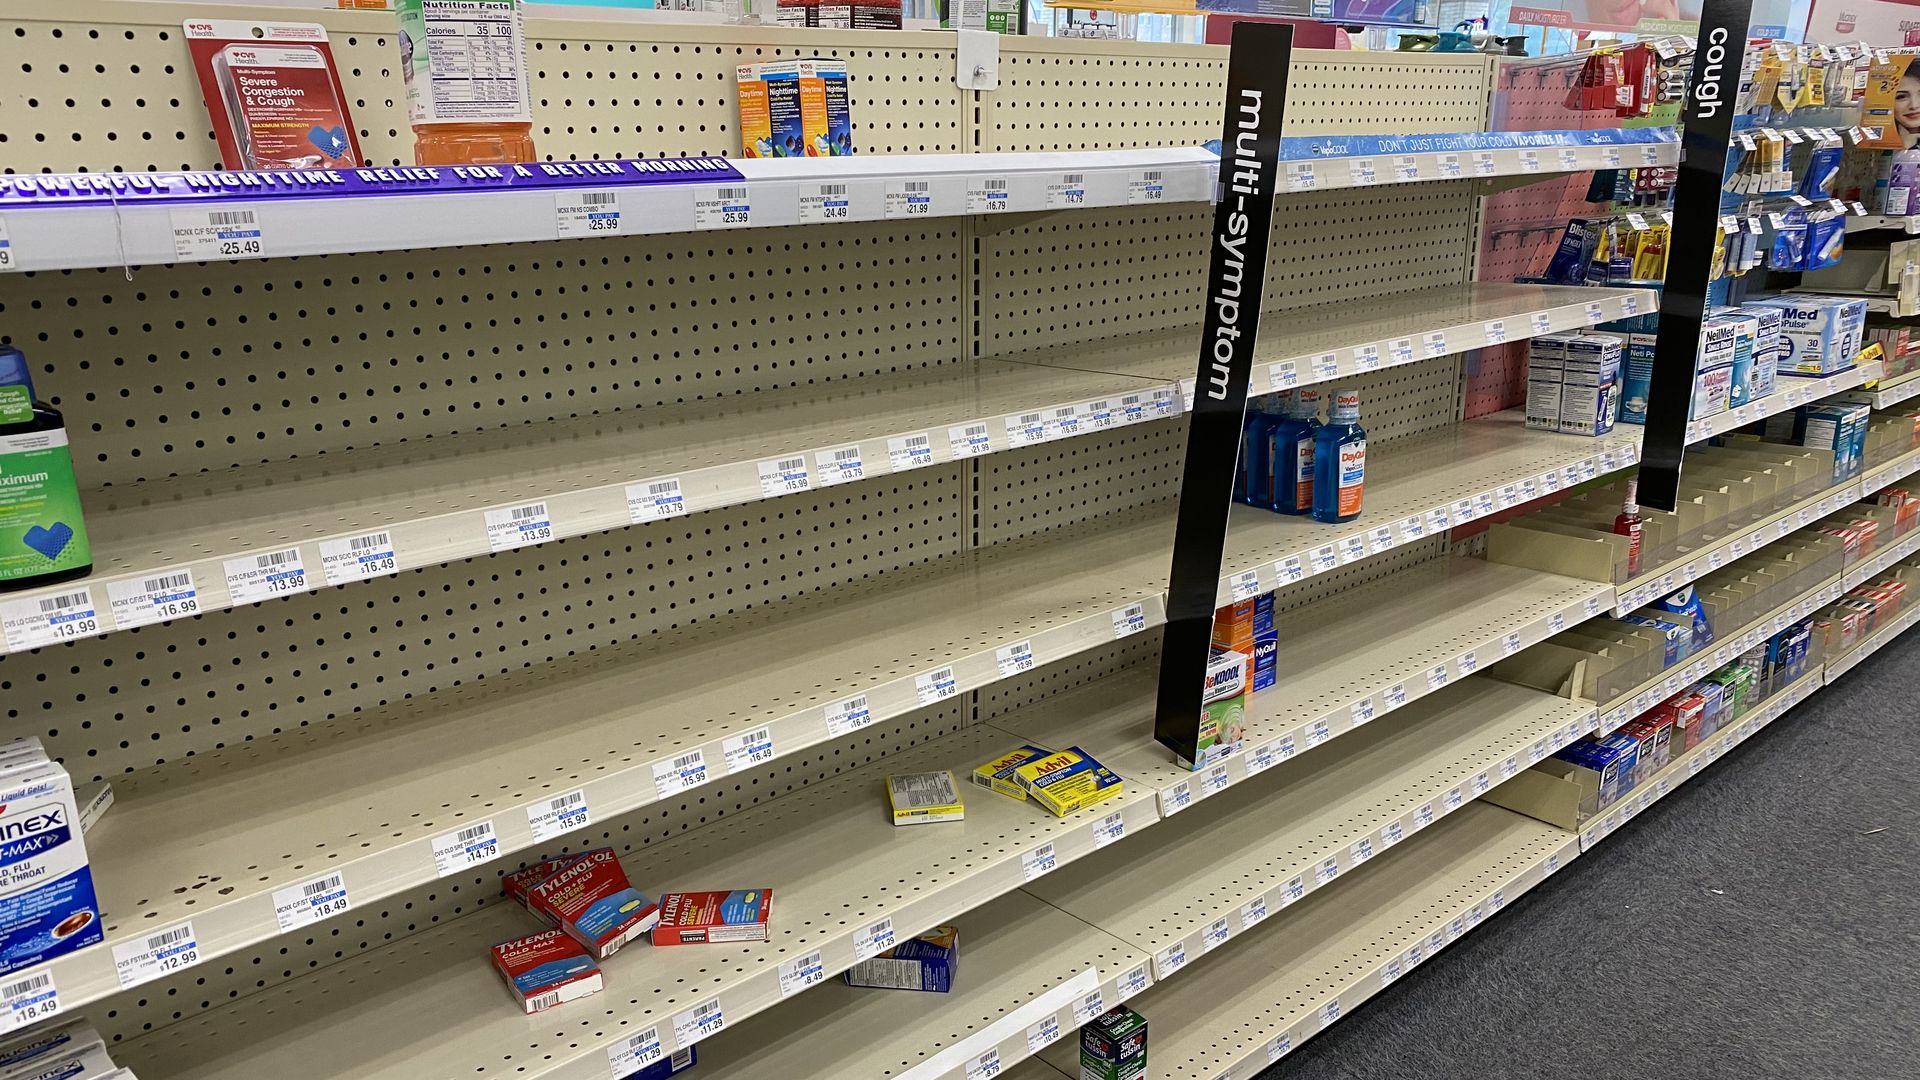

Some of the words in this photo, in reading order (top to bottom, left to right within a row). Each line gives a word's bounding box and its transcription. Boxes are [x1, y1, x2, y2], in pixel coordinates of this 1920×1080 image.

[423, 1, 475, 9] Nutrition
[479, 2, 509, 10] Facts
[1535, 13, 1567, 24] MOISTURIZER
[476, 26, 488, 35] 35
[496, 26, 512, 35] 100
[1695, 27, 1728, 119] cough
[239, 76, 278, 87] Severe
[242, 86, 305, 97] Congestion
[769, 87, 799, 97] Nighttime
[246, 97, 255, 106] &
[257, 97, 295, 107] Cough
[1379, 139, 1408, 153] DON'T
[1410, 139, 1434, 151] JUST
[1435, 137, 1461, 150] FIGHT
[1461, 137, 1488, 148] YOUR
[1489, 136, 1512, 147] COLD
[1512, 134, 1553, 146] VAPORIZE
[0, 174, 170, 195] POWERFUL
[184, 168, 344, 192] NIGHTTIME
[356, 166, 442, 184] RELIEF
[452, 163, 503, 182] FOR
[513, 162, 533, 179] A
[541, 160, 626, 177] BETTER
[631, 157, 730, 175] MORNING
[823, 207, 847, 218] $24.49
[907, 203, 928, 213] $21.99
[986, 201, 1006, 210] $16.79
[589, 219, 618, 230] $25.99
[722, 212, 748, 223] $25.99
[174, 228, 194, 236] MCNX
[194, 228, 205, 236] C/F
[1569, 223, 1596, 241] Blistex
[220, 241, 260, 255] $25.49
[1208, 88, 1262, 401] multi-symptom
[1706, 326, 1735, 343] NeilMed
[1127, 413, 1142, 421] $21.99
[1061, 425, 1078, 434] $16.99
[1026, 433, 1043, 441] $15.99
[971, 444, 989, 454] $21.99
[911, 455, 931, 465] $16.49
[842, 468, 863, 480] $13.79
[786, 479, 808, 491] $15.99
[658, 502, 683, 515] $13.79
[488, 523, 497, 531] CVS
[521, 527, 550, 542] $13.99
[322, 555, 338, 564] MCNX
[352, 551, 362, 559] RLF
[363, 549, 371, 557] LQ
[360, 558, 394, 574] $16.49
[227, 574, 239, 582] CVS
[268, 576, 305, 592] $13.99
[112, 597, 129, 607] MCNX
[158, 600, 197, 617] $16.99
[4, 620, 15, 628] CVS
[53, 619, 96, 638] $13.99
[1256, 641, 1276, 658] NyQuil
[1016, 659, 1033, 671] $12.99
[938, 688, 955, 698] $18.49
[851, 715, 871, 728] $16.49
[750, 750, 772, 763] $16.49
[992, 753, 1026, 772] Advil
[1036, 755, 1072, 776] Advil
[682, 772, 705, 787] $15.99
[1040, 779, 1052, 787] COLD
[27, 784, 48, 796] Gels!
[529, 816, 543, 825] MCNX
[543, 813, 551, 821] DM
[552, 810, 561, 818] RLF
[560, 813, 587, 830] $15.99
[434, 849, 444, 858] CVS
[454, 843, 464, 852] SRE
[464, 839, 476, 849] THRT
[467, 845, 496, 863] $14.79
[14, 862, 31, 875] FLU
[1041, 860, 1055, 871] $8.29
[12, 867, 46, 886] THROAT
[534, 857, 595, 898] TYLENOL
[548, 889, 571, 904] COLD
[576, 872, 593, 885] FLU
[552, 883, 586, 907] SEVERE
[276, 903, 292, 914] MCNX
[292, 897, 309, 909] C/F/ST
[314, 898, 347, 918] $18.49
[658, 894, 681, 927] TYLENOL
[679, 912, 689, 926] COLD
[684, 898, 693, 909] FLU
[495, 929, 564, 955] TYLENOL
[876, 937, 895, 950] $11.29
[502, 948, 529, 959] COLD
[533, 940, 555, 951] MAX
[117, 959, 129, 969] CVS
[130, 954, 150, 965] FSTMX
[160, 951, 197, 972] $12.99
[805, 972, 823, 984] $8.49
[16, 1000, 57, 1023] $18.49
[701, 1018, 723, 1035] $11.29
[1102, 1013, 1123, 1026] tussin
[1085, 1032, 1101, 1046] Safe
[1120, 1038, 1136, 1053] Safe
[637, 1048, 661, 1065] $11.29
[1085, 1041, 1107, 1058] tussin
[1120, 1043, 1141, 1060] tussin
[985, 1066, 999, 1078] $8.79
